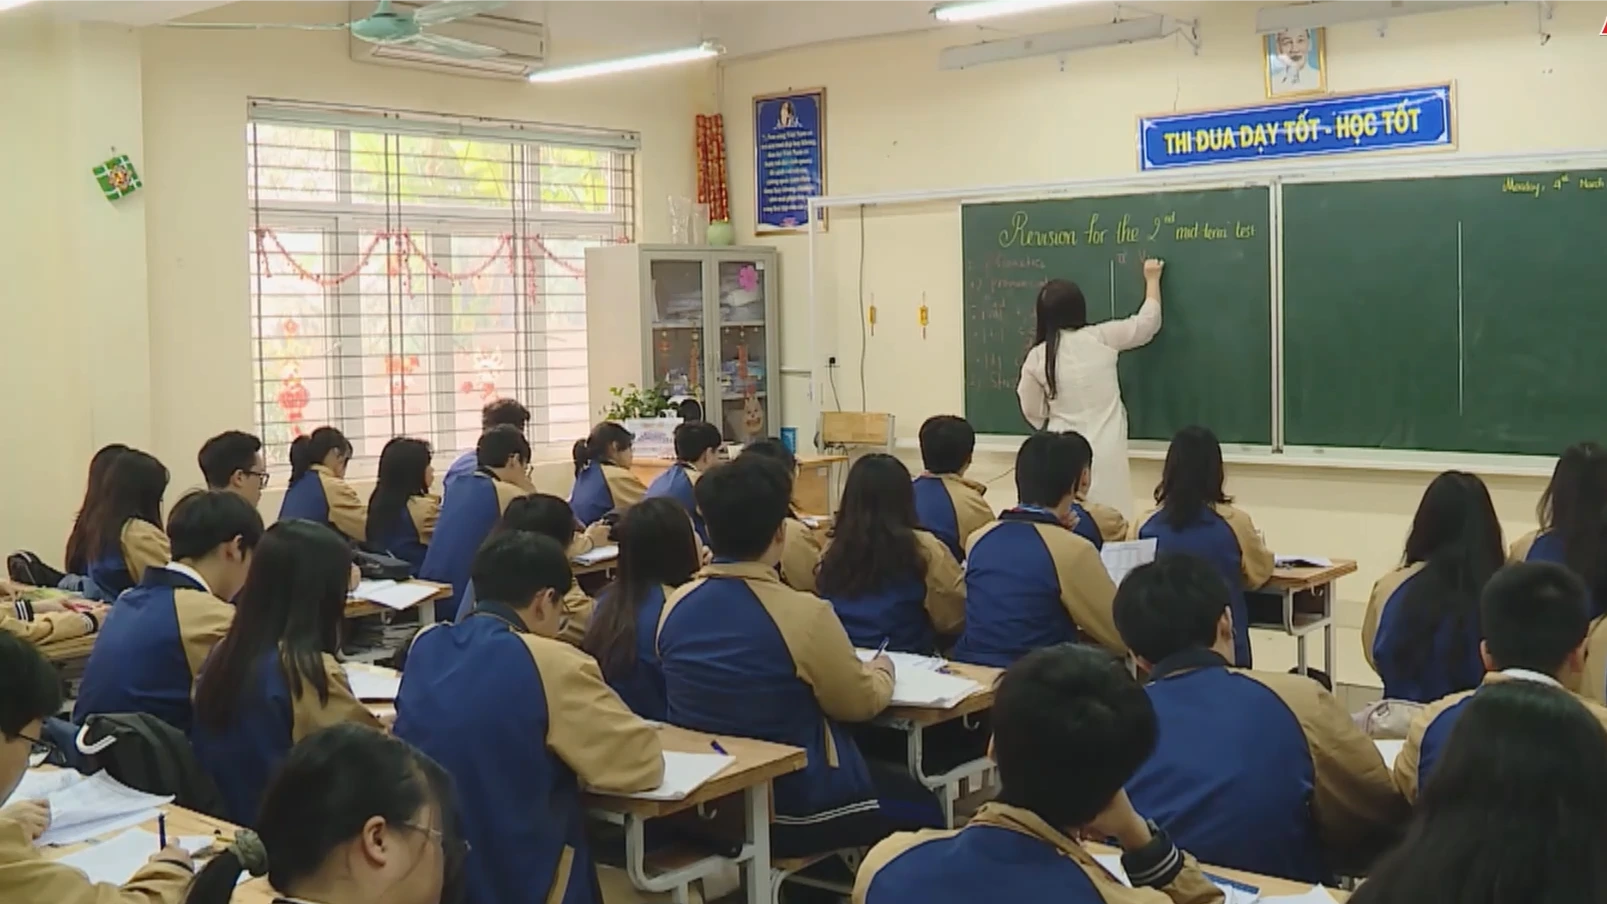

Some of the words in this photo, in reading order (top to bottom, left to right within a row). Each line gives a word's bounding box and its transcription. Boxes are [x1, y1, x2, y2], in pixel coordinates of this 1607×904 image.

[1163, 131, 1192, 155] THI
[1195, 127, 1236, 152] ĐUA
[1240, 121, 1279, 153] DẠY
[1283, 108, 1320, 144] TỐT
[1336, 112, 1378, 145] HỌC
[1381, 98, 1421, 135] TỐT
[999, 211, 1077, 247] Revision
[1084, 212, 1107, 244] for
[1116, 214, 1139, 244] the
[1235, 221, 1255, 239] test
